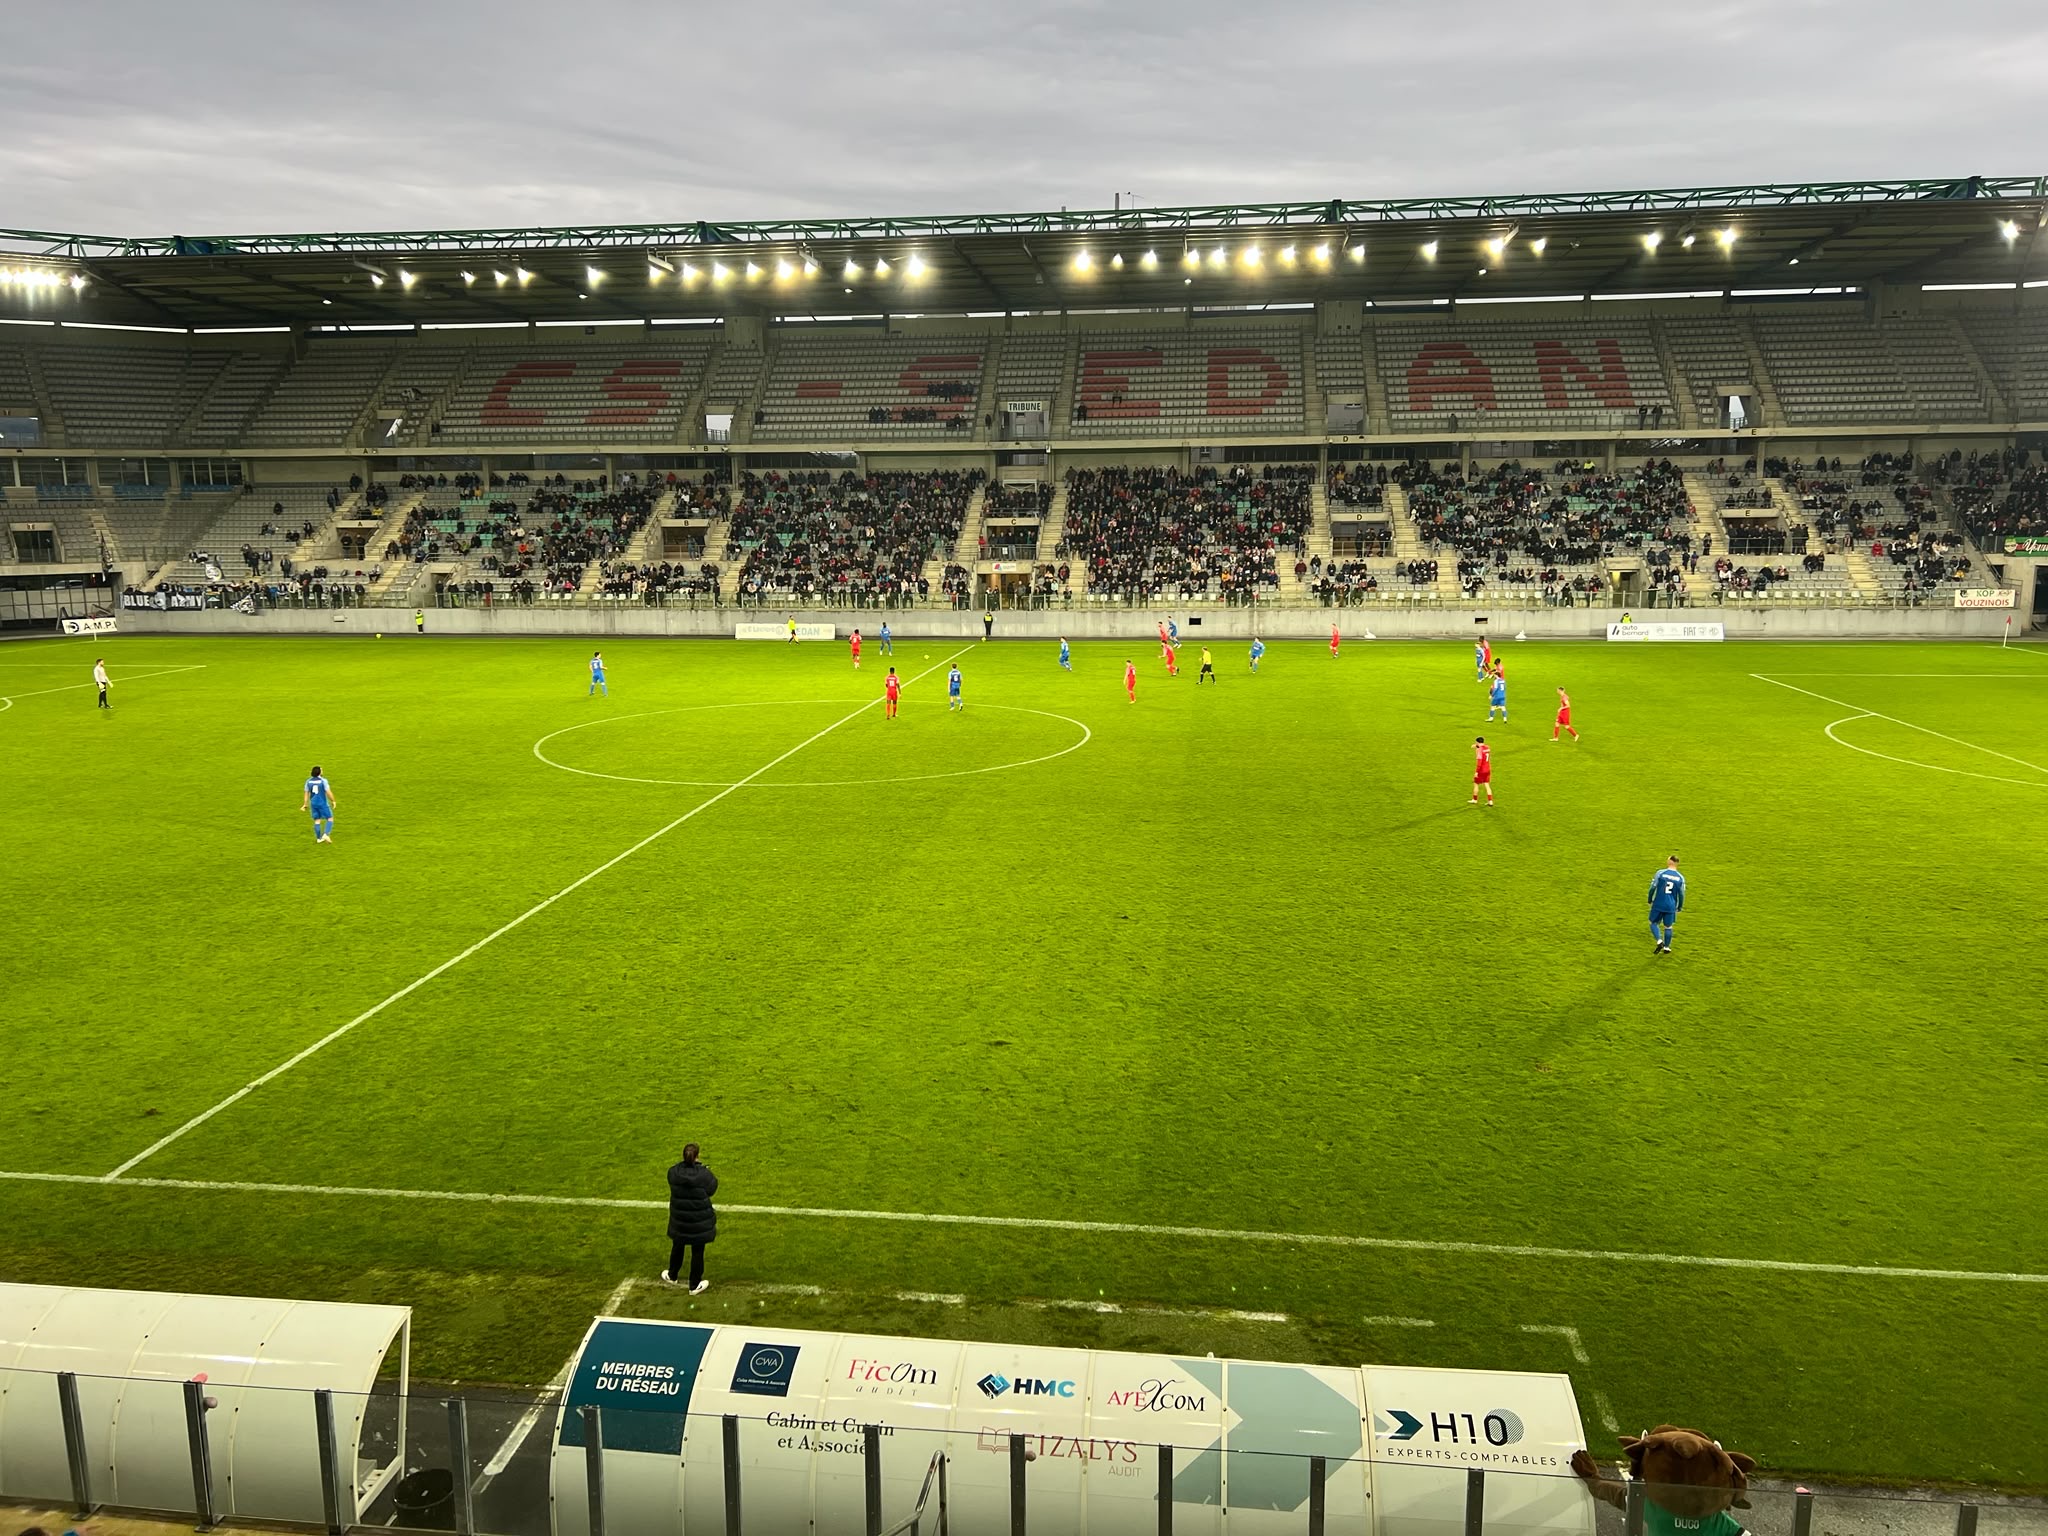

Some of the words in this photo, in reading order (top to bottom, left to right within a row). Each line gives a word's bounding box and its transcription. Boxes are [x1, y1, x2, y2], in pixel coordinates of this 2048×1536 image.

[1008, 403, 1041, 412] TRIBUNE
[124, 595, 150, 607] BLUE
[1959, 599, 2010, 607] VOUZINOIS
[794, 627, 820, 636] EDAN
[1683, 627, 1697, 636] FIAT
[1664, 881, 1674, 894] 2
[755, 1357, 778, 1367] CWA
[600, 1361, 674, 1379] MEMBRES
[596, 1376, 619, 1391] DU
[620, 1377, 680, 1396] RÉSEAU
[1013, 1378, 1076, 1398] HMC
[766, 1411, 816, 1431] Cabin
[821, 1419, 837, 1432] et
[1430, 1411, 1509, 1446] H10
[777, 1436, 793, 1449] et
[1387, 1447, 1558, 1467] EXPERTS-COMPTABLES
[1108, 1465, 1143, 1478] AUDIT
